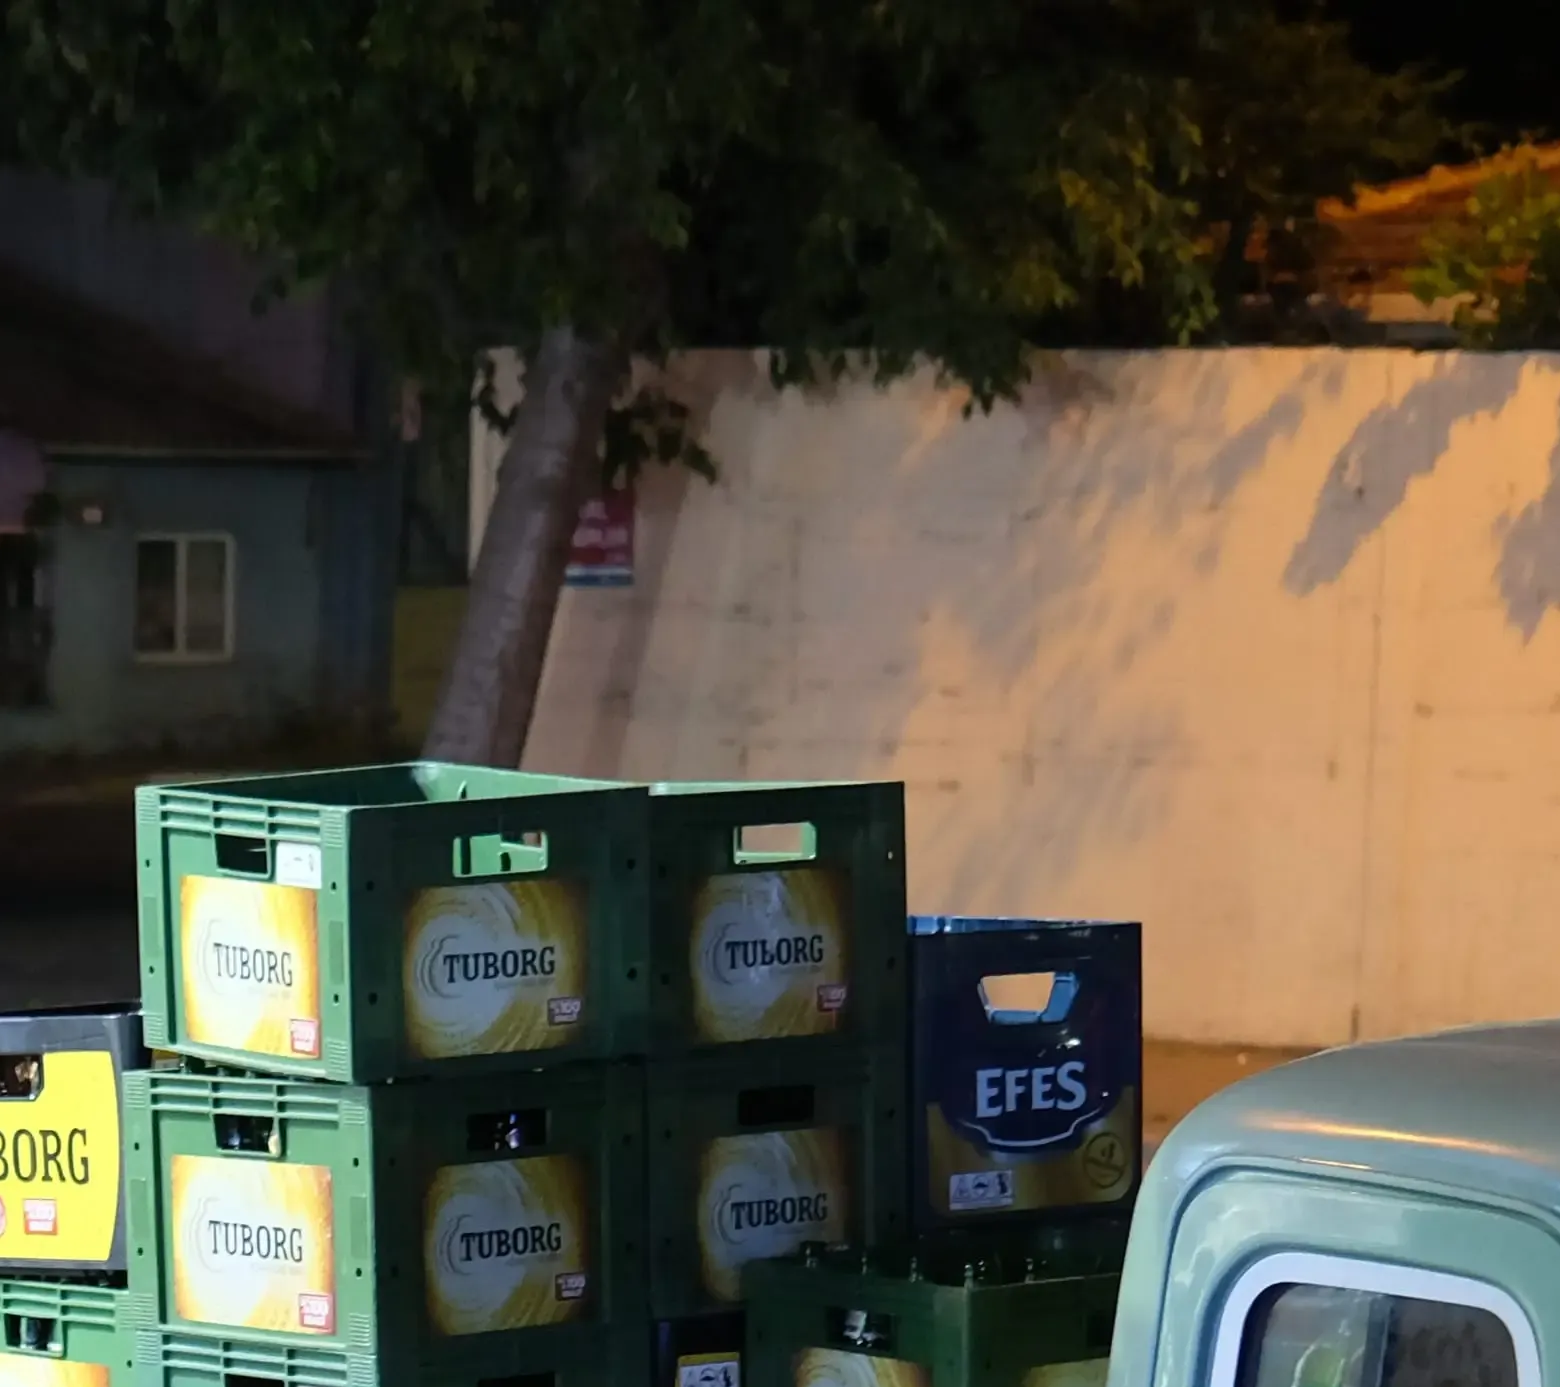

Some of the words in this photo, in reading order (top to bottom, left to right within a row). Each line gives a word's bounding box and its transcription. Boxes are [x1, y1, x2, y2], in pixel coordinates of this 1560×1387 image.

[212, 940, 294, 989] TUBORG
[442, 945, 556, 985] TUBORG
[976, 1061, 1087, 1119] EFES
[730, 1191, 828, 1232] TUBORG
[208, 1220, 304, 1264] TUBORG
[458, 1221, 563, 1264] TUBORG
